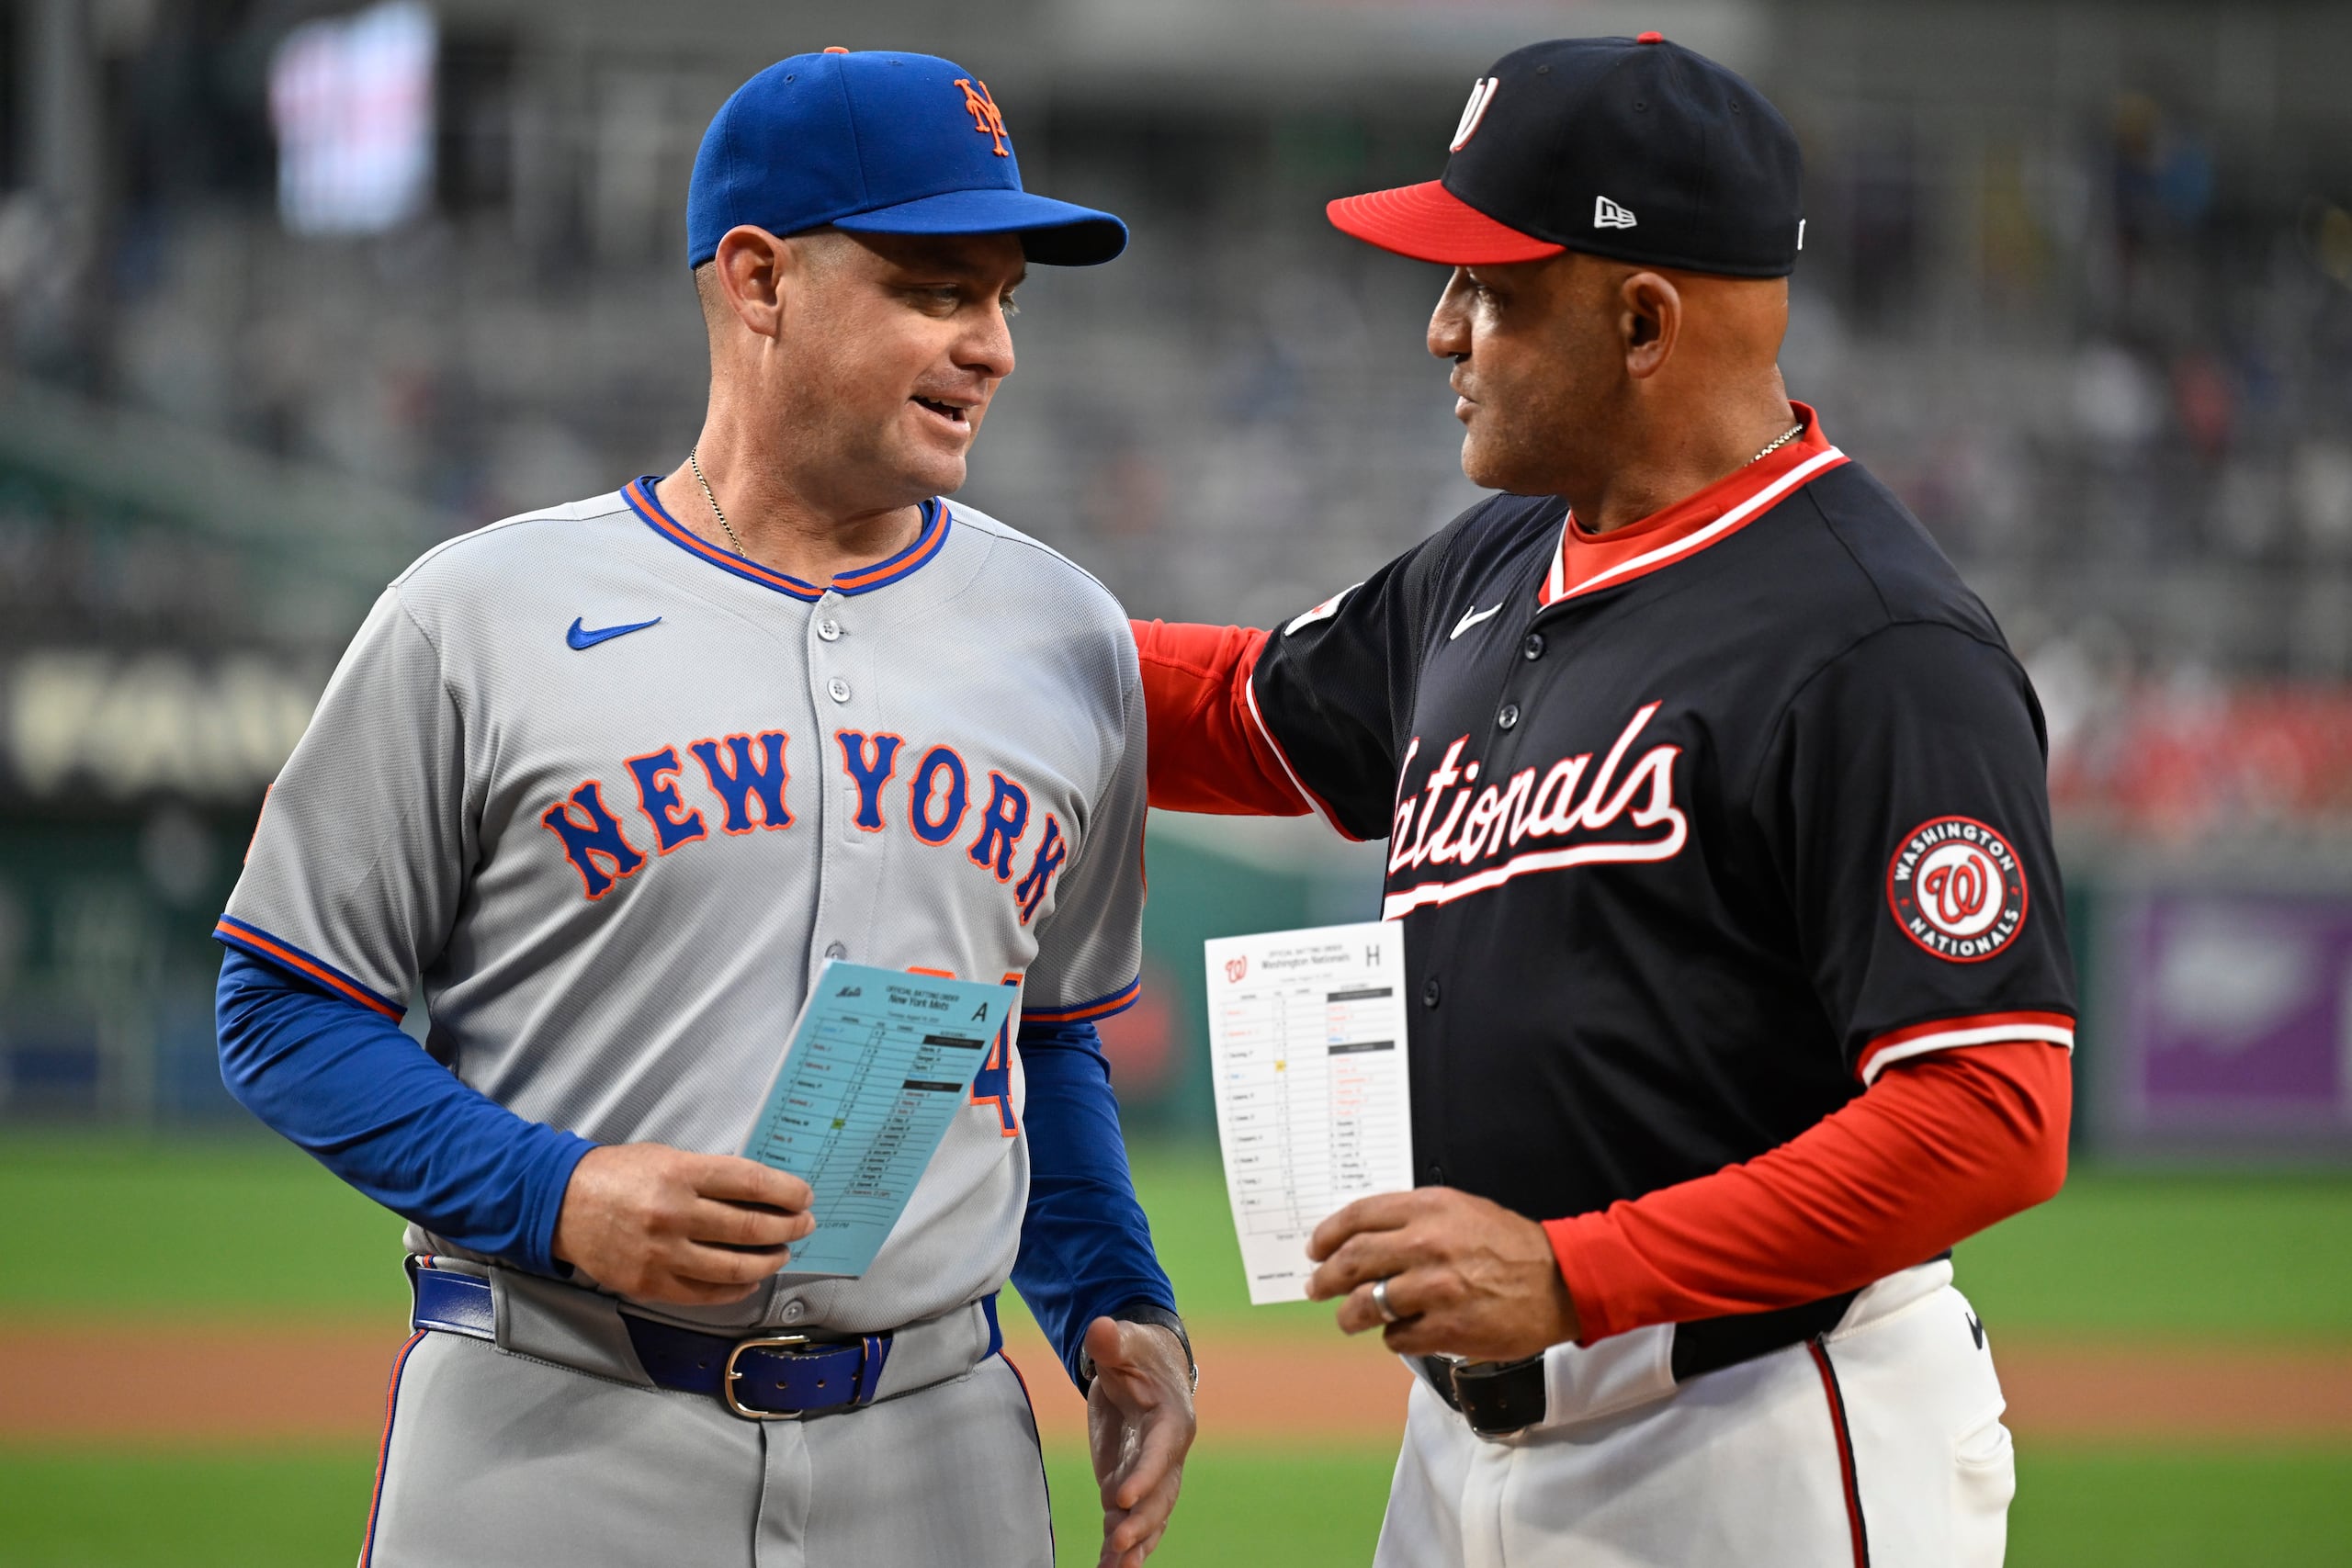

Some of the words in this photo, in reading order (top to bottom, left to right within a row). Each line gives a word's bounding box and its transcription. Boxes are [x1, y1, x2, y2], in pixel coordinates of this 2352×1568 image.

[1385, 699, 1689, 884] ationals
[540, 729, 795, 901] NEW
[834, 728, 1068, 926] YORK
[1894, 822, 2015, 881] WASHINGTON
[1924, 853, 1987, 925] W
[1365, 944, 1380, 967] H
[1909, 908, 2019, 956] NATIONALS
[888, 995, 907, 1006] New
[909, 997, 927, 1009] York
[928, 999, 950, 1011] Mets
[971, 1001, 989, 1022] A
